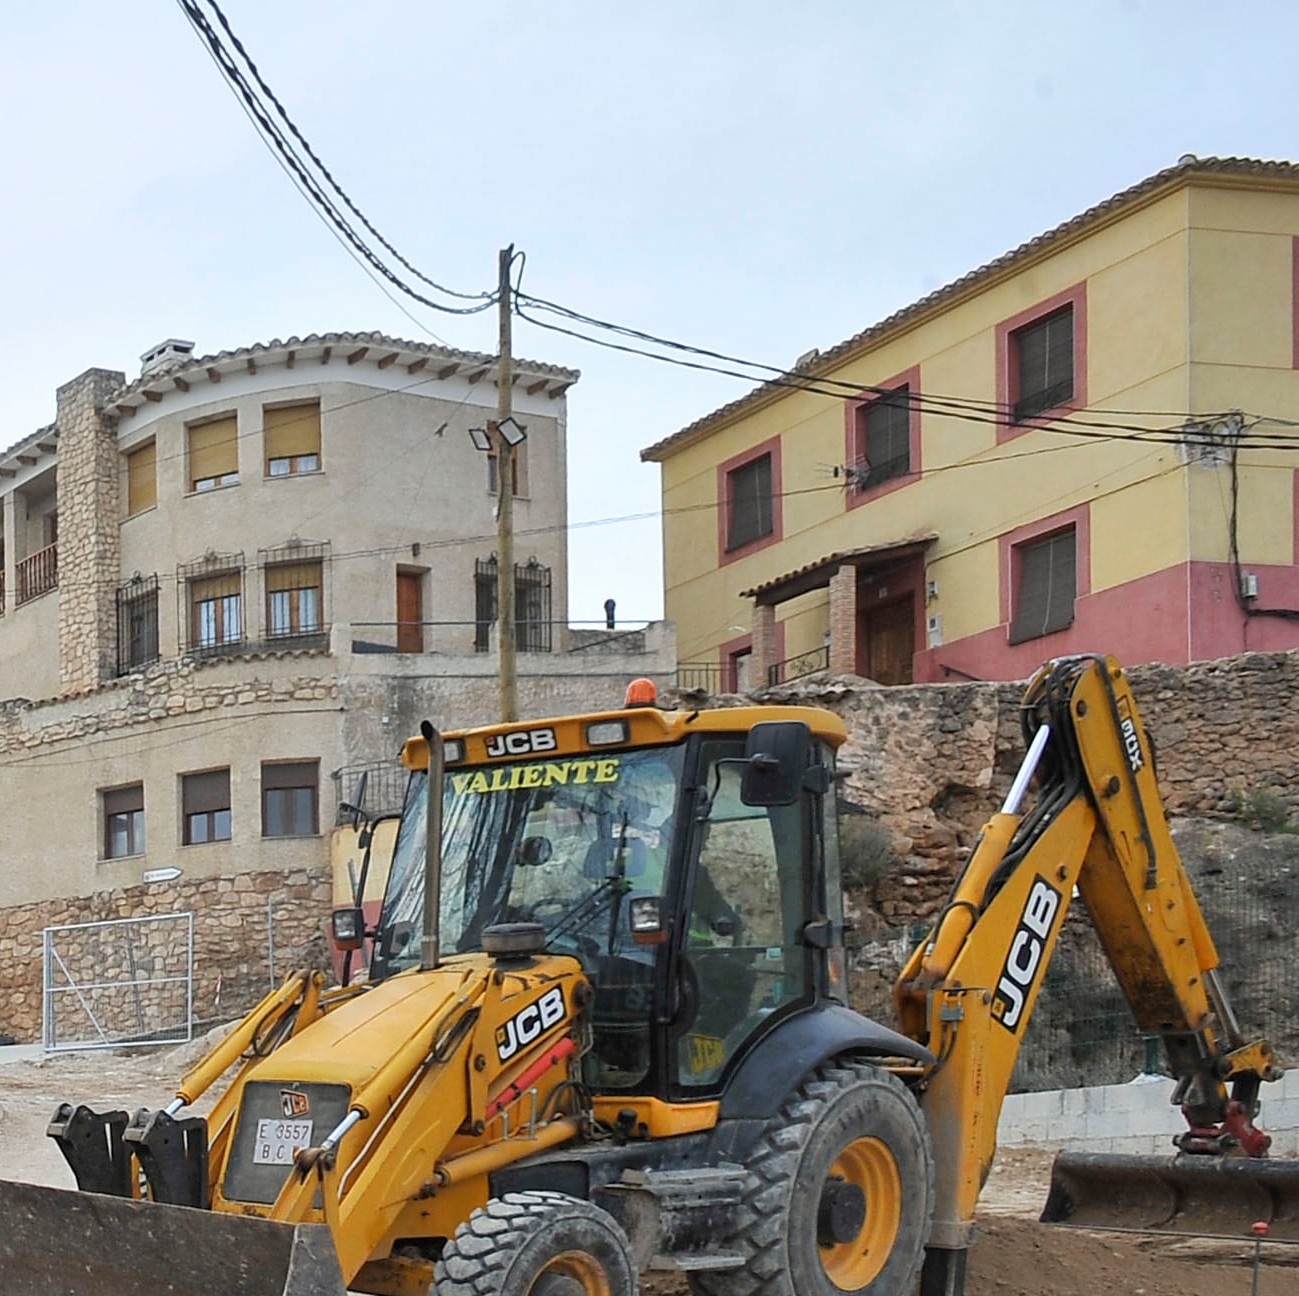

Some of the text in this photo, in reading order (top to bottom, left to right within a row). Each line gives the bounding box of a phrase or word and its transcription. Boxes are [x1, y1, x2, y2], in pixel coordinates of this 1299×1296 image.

[488, 728, 556, 757] JCB
[452, 759, 619, 795] VALIENTE
[999, 881, 1058, 1027] JCB
[498, 988, 565, 1060] JCB
[259, 1123, 310, 1141] E 3557
